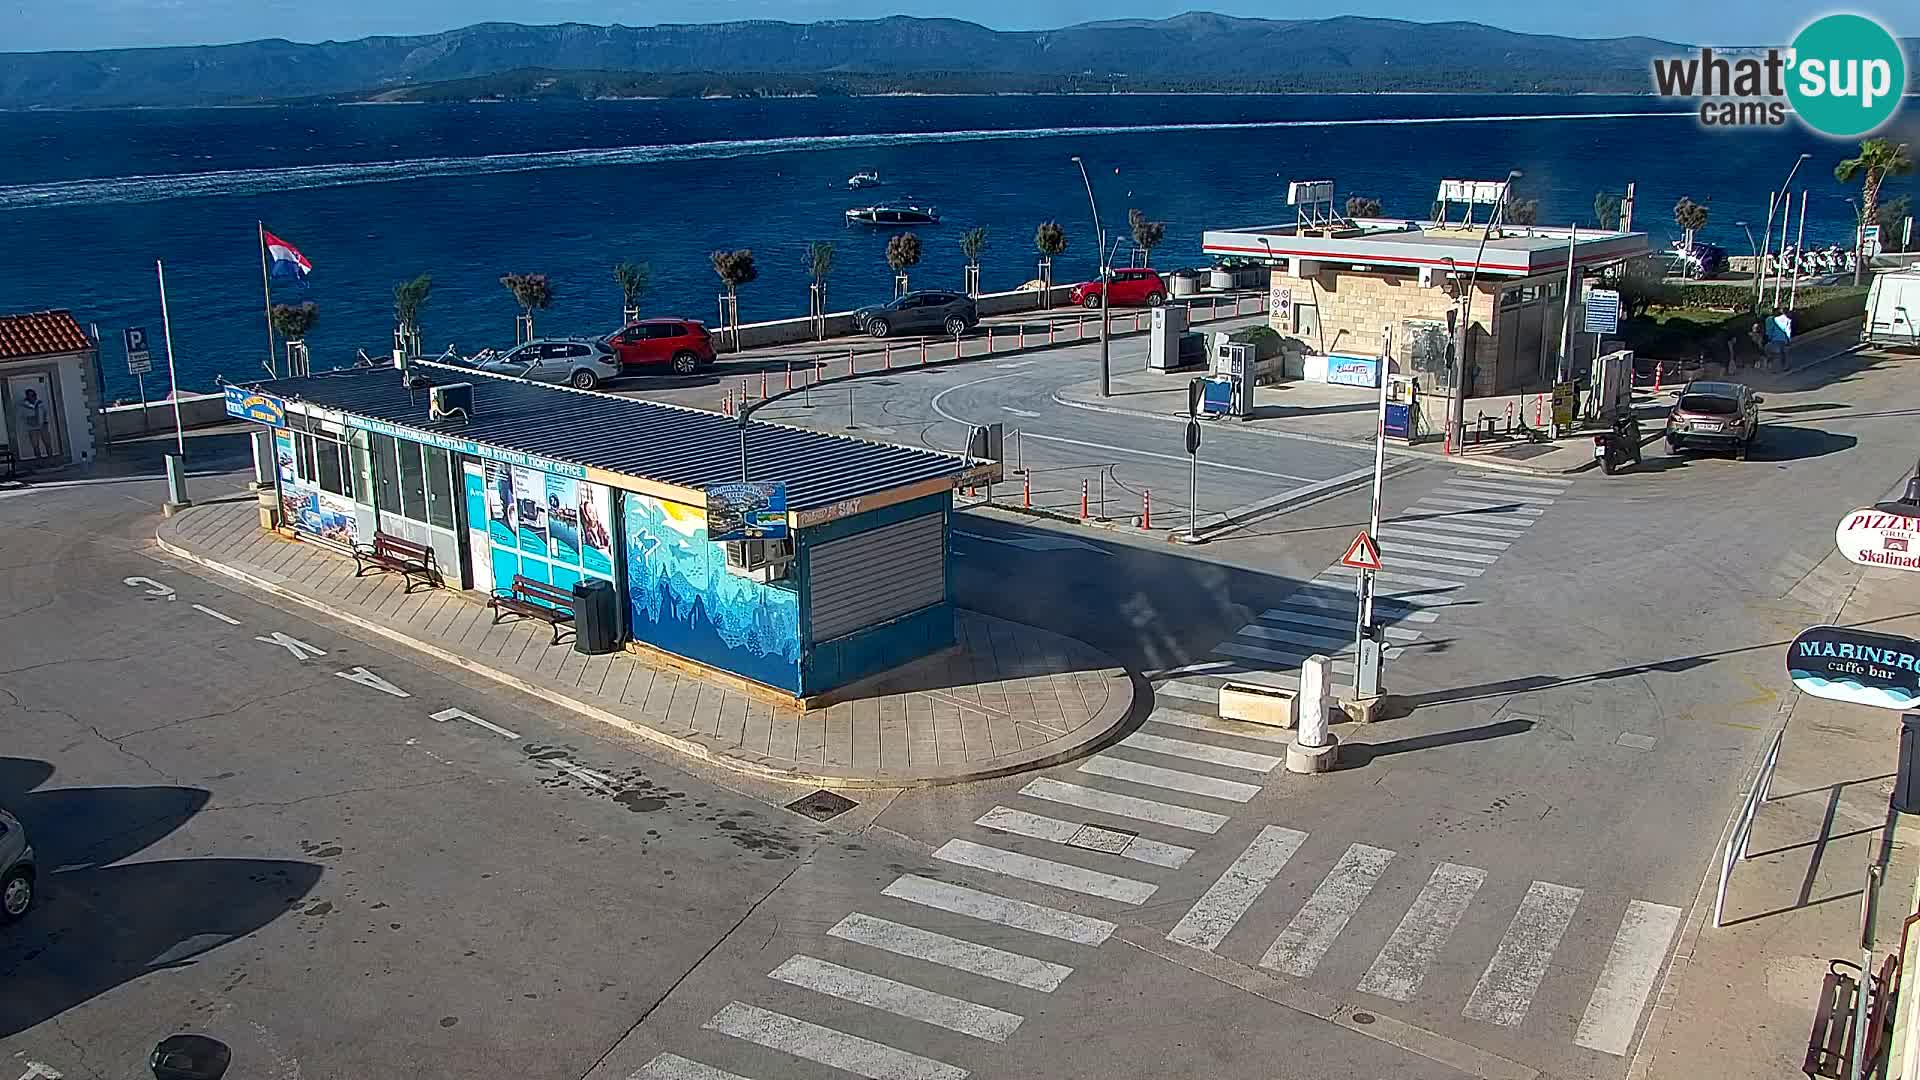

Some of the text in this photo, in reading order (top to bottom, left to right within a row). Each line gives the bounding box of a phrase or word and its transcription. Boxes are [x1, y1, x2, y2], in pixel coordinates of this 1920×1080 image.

[129, 331, 142, 349] P
[436, 435, 467, 451] POSTAJA
[477, 445, 492, 457] BUS
[493, 449, 526, 465] STATION
[527, 456, 554, 471] TICKET
[554, 462, 582, 477] OFFICE
[1880, 529, 1917, 540] GRILL
[1828, 661, 1896, 679] caffe bar
